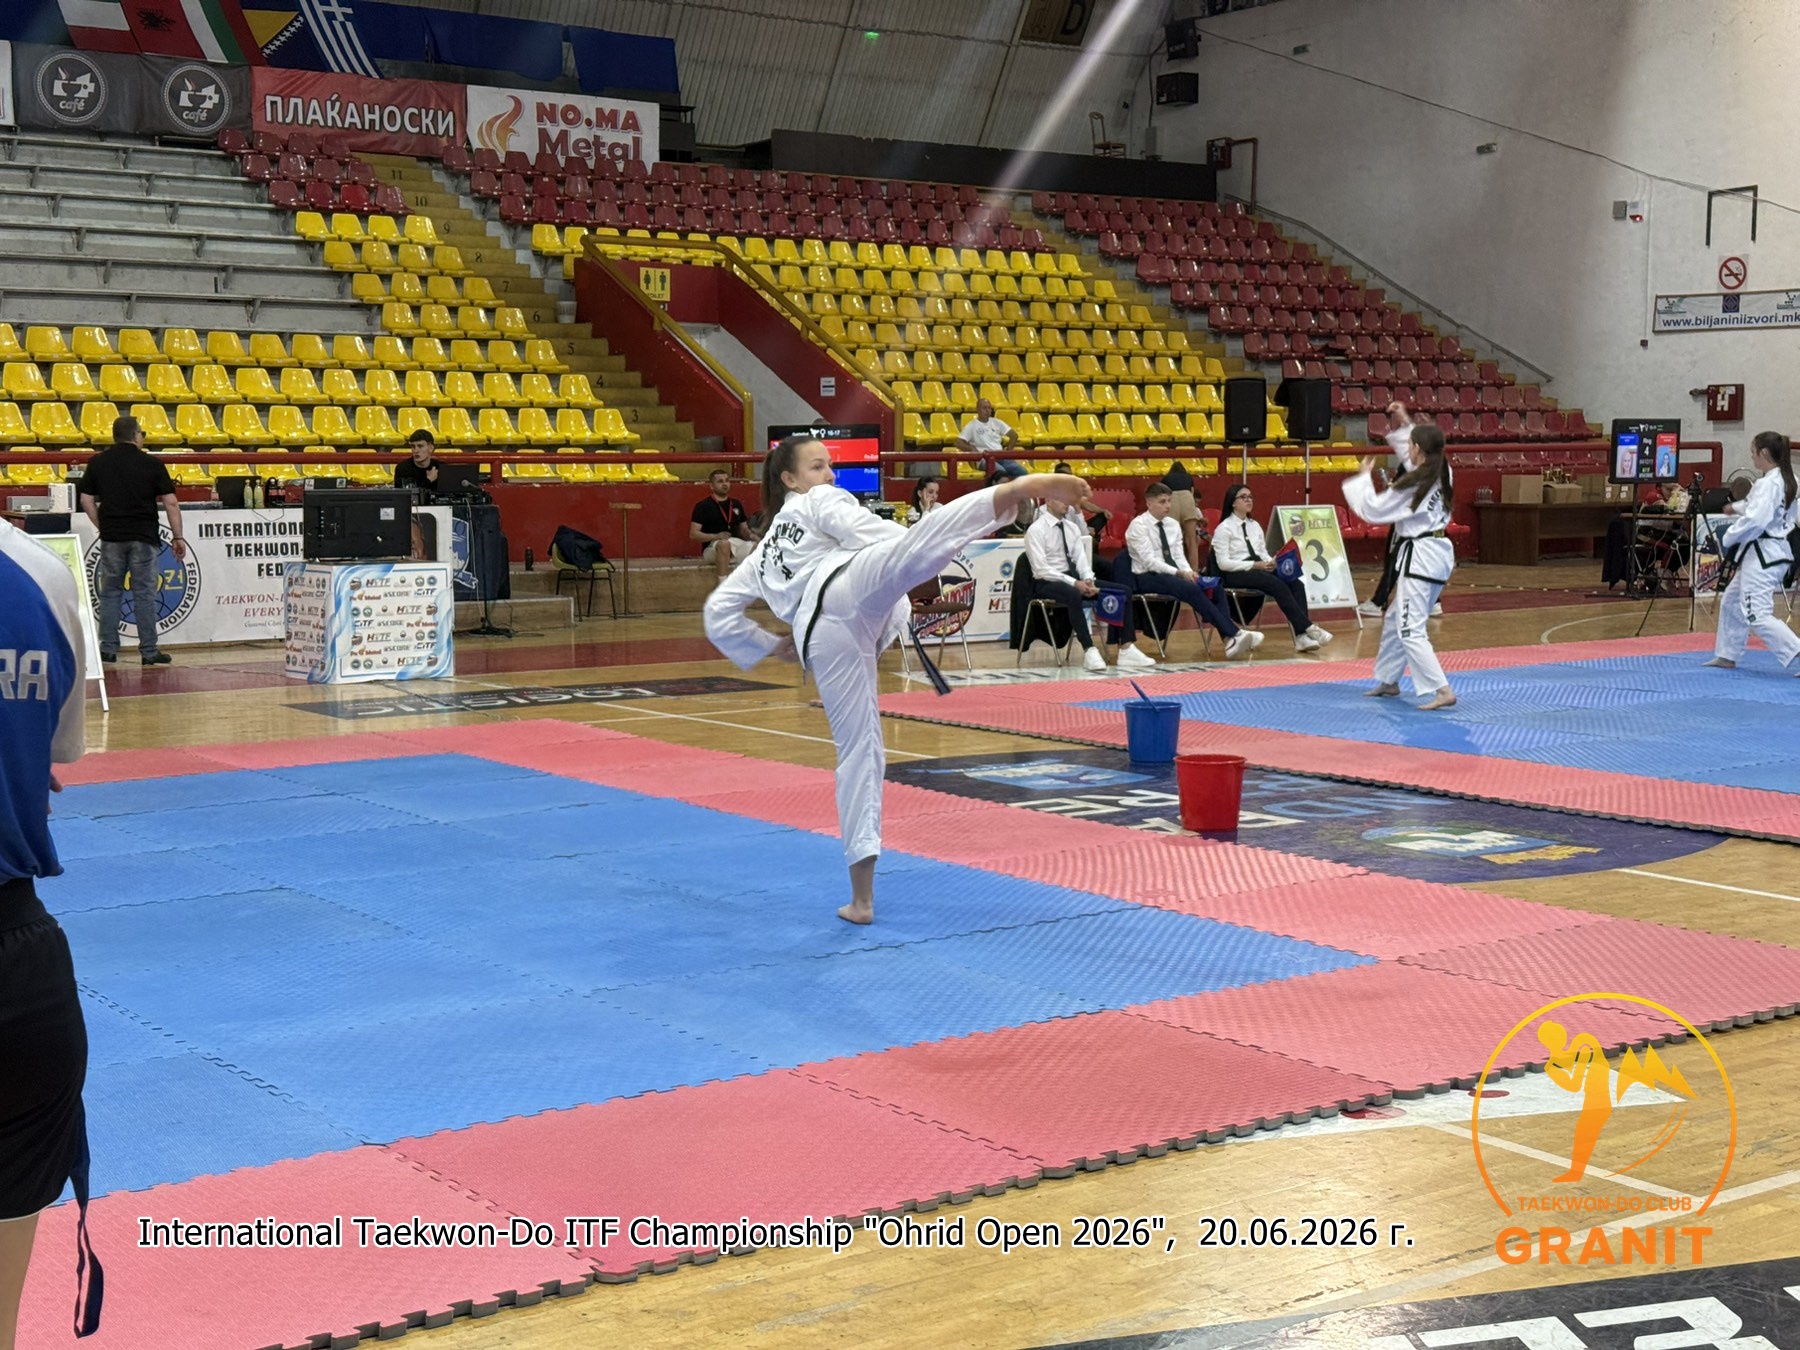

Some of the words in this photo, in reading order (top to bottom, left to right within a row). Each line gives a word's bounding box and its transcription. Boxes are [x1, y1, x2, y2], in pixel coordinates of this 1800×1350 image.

[59, 99, 85, 113] café
[182, 109, 208, 121] café
[264, 93, 455, 137] ПЛАЌАНОСКИ
[538, 128, 643, 163] Metal
[392, 170, 402, 180] 11
[415, 195, 428, 207] 10
[442, 222, 451, 235] 9
[475, 251, 483, 263] 8
[502, 280, 510, 293] 7
[532, 310, 541, 323] 6
[567, 342, 575, 355] 5
[596, 375, 604, 388] 4
[631, 409, 639, 423] 3
[1644, 446, 1650, 456] 4
[225, 542, 304, 558] TAEKWON-
[1305, 538, 1330, 582] 3
[257, 563, 284, 577] FED
[159, 562, 197, 631] FEDERATION
